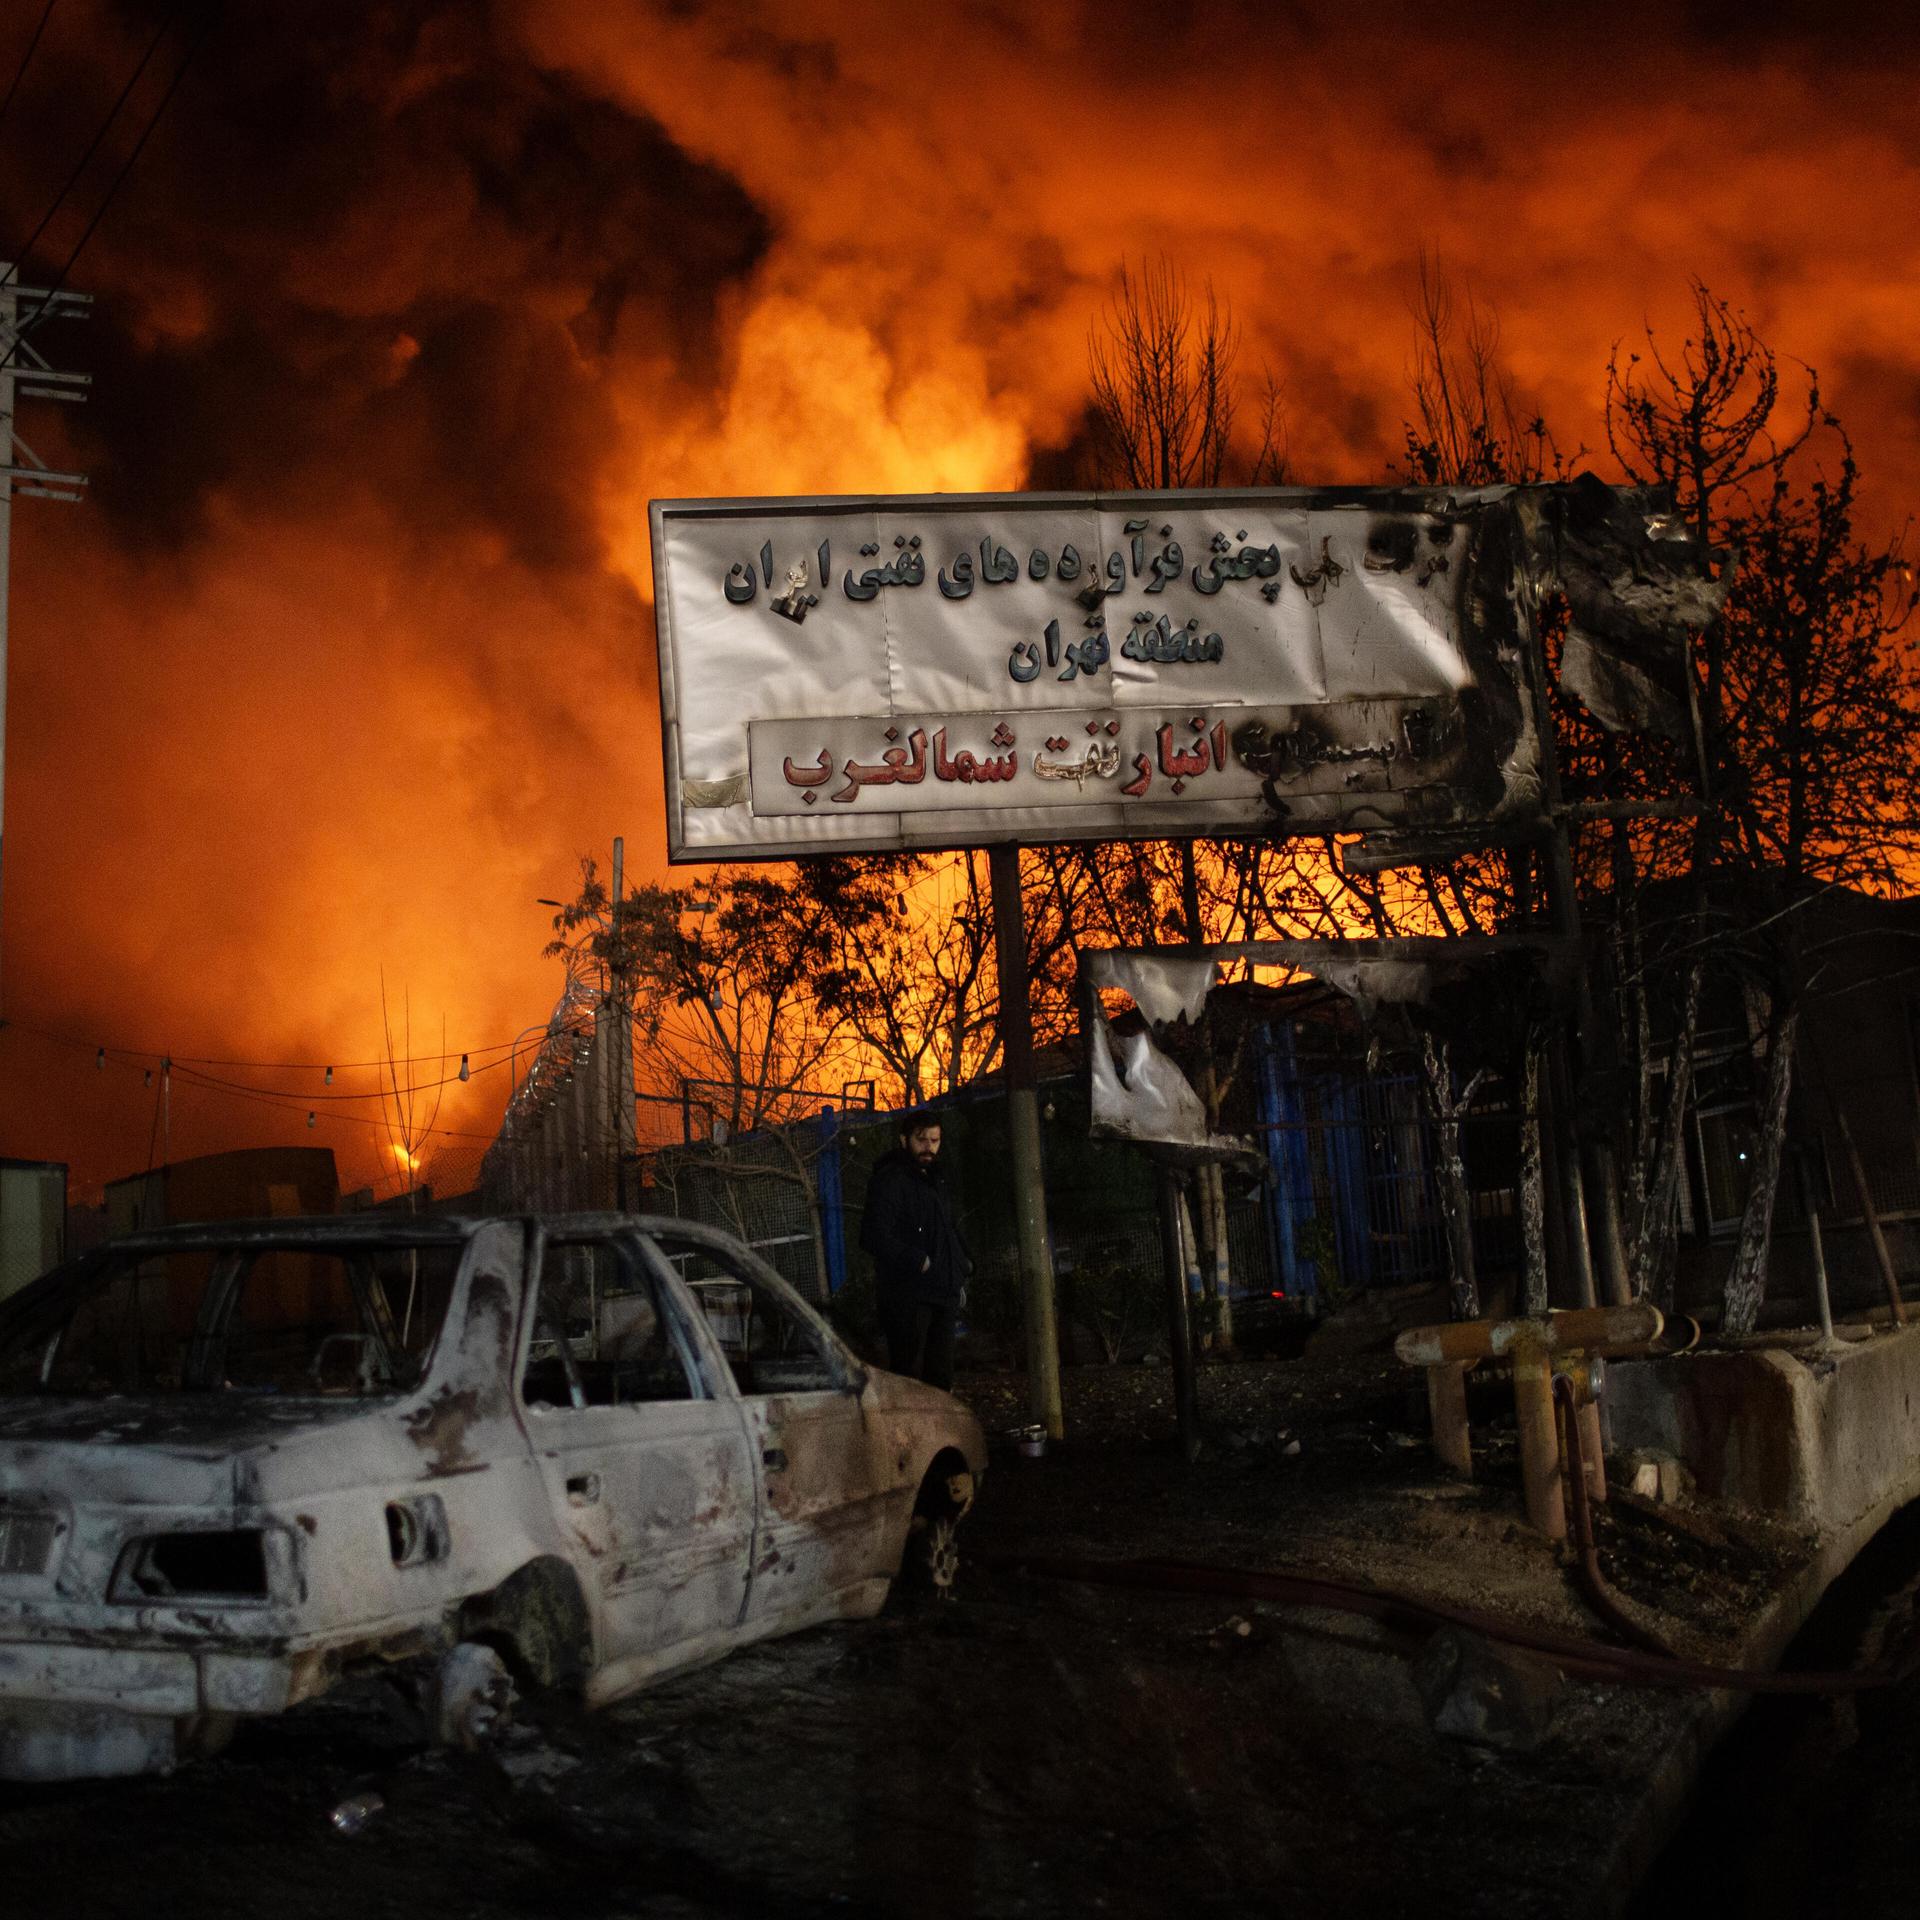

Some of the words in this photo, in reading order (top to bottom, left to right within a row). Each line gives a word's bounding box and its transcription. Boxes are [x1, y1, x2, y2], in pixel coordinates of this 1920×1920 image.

[843, 535, 925, 600] نفتی
[1192, 528, 1281, 603] پخش
[1009, 614, 1111, 682] تهران
[1120, 610, 1224, 664] منطقه
[1033, 719, 1121, 784] نفت
[1120, 716, 1228, 797] انبار
